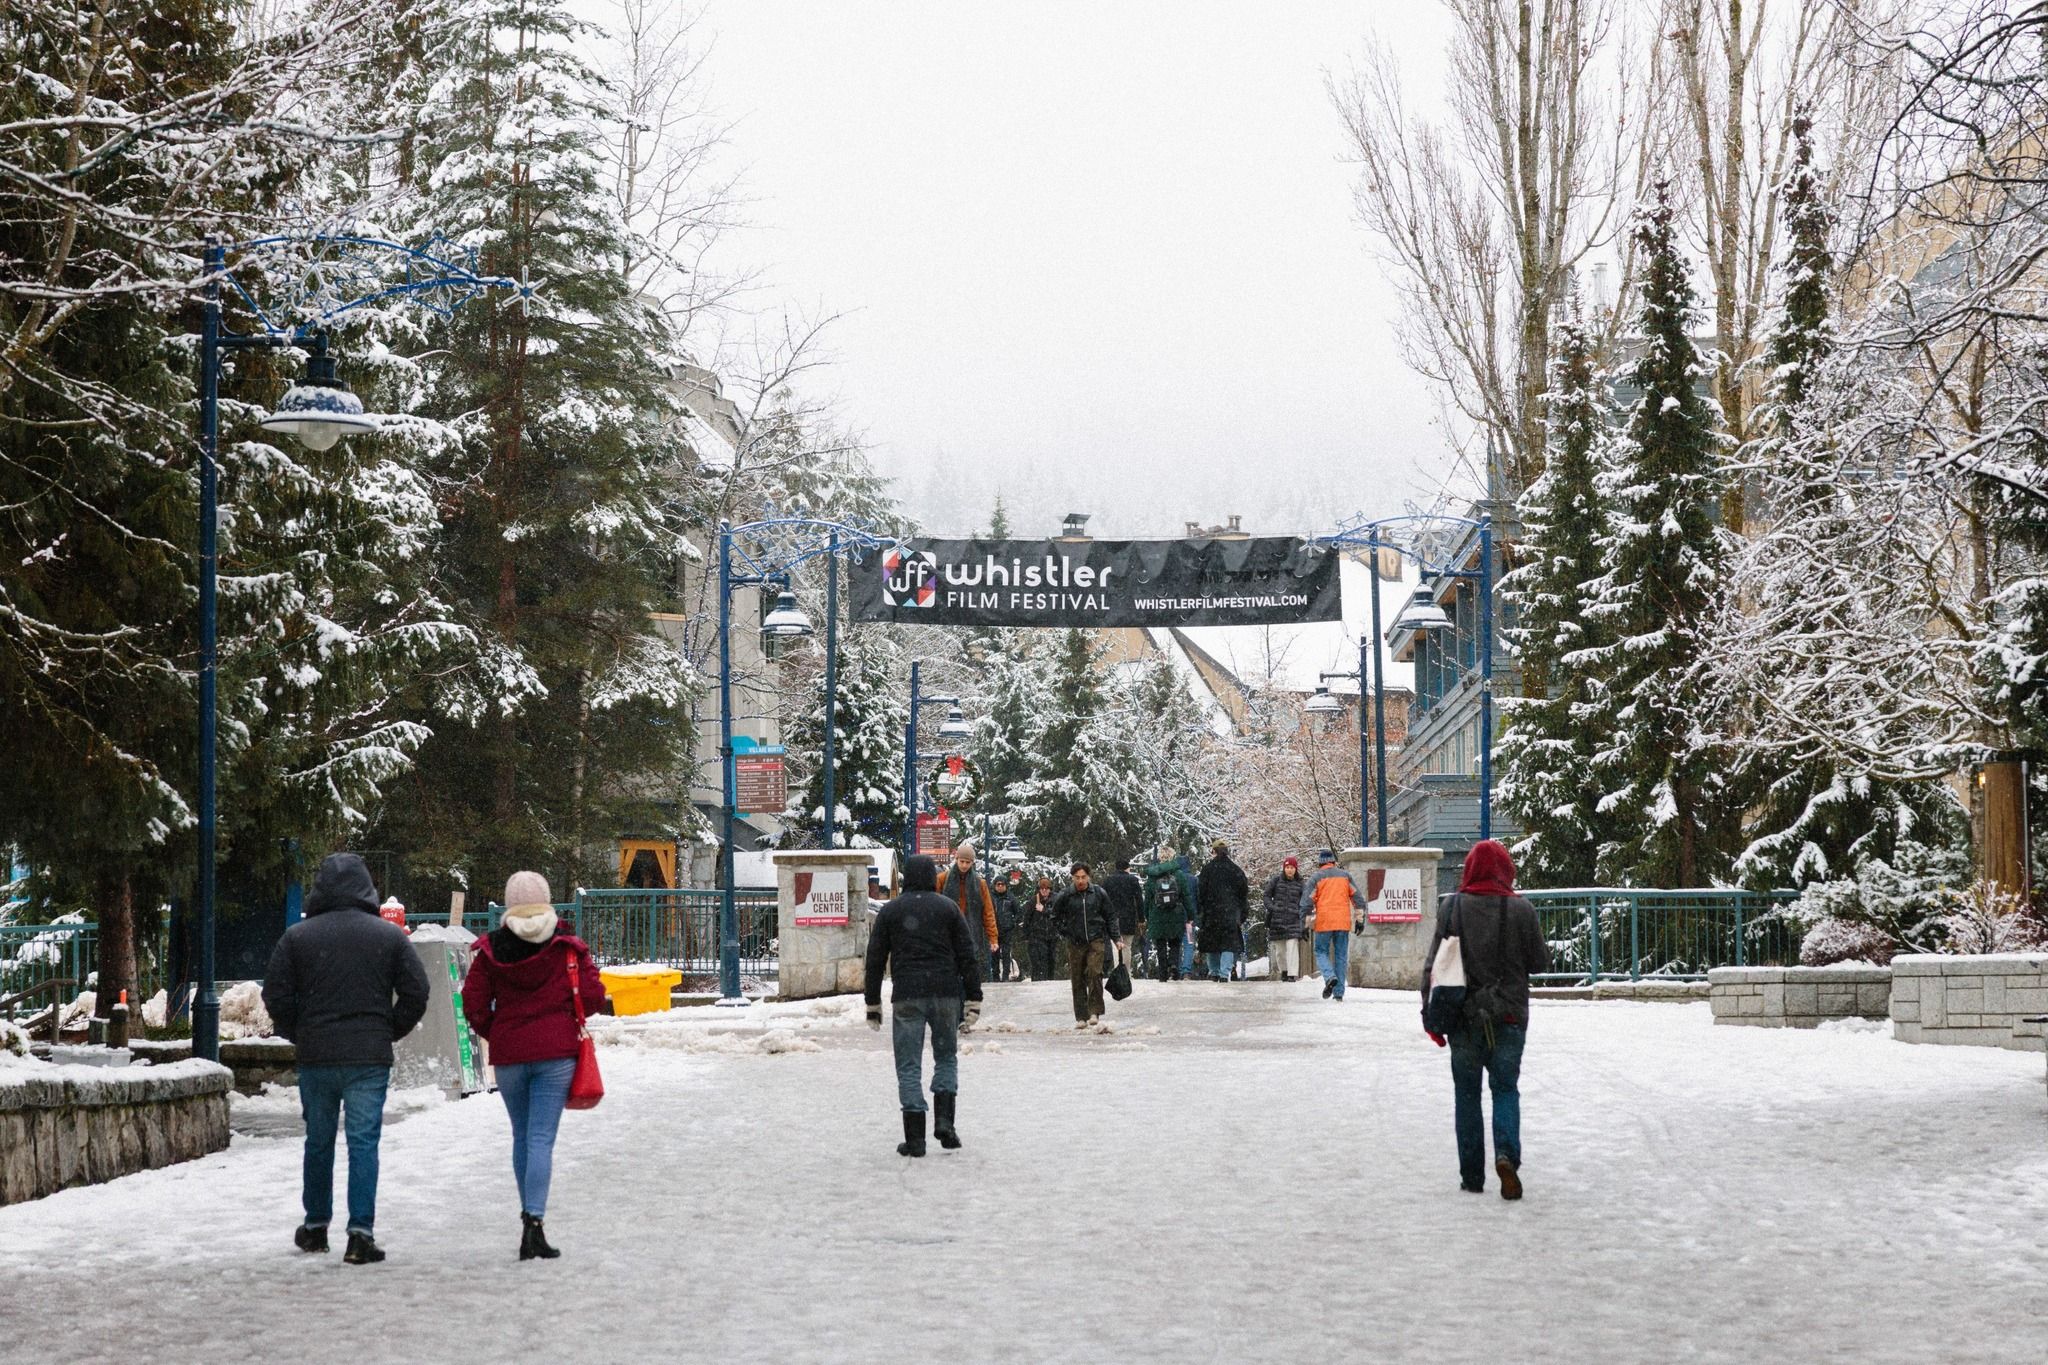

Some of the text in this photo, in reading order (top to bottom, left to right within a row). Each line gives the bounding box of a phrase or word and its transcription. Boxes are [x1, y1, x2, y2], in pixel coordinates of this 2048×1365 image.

[945, 554, 1112, 588] whistler
[947, 591, 1110, 610] FILM FESTIVAL
[1134, 595, 1308, 610] WHISTLERFILMFESTIVAL.COM
[811, 892, 845, 903] VILLAGE
[1383, 889, 1418, 899] VILLAGE
[813, 903, 845, 913] CENTRE
[1386, 900, 1418, 910] CENTRE
